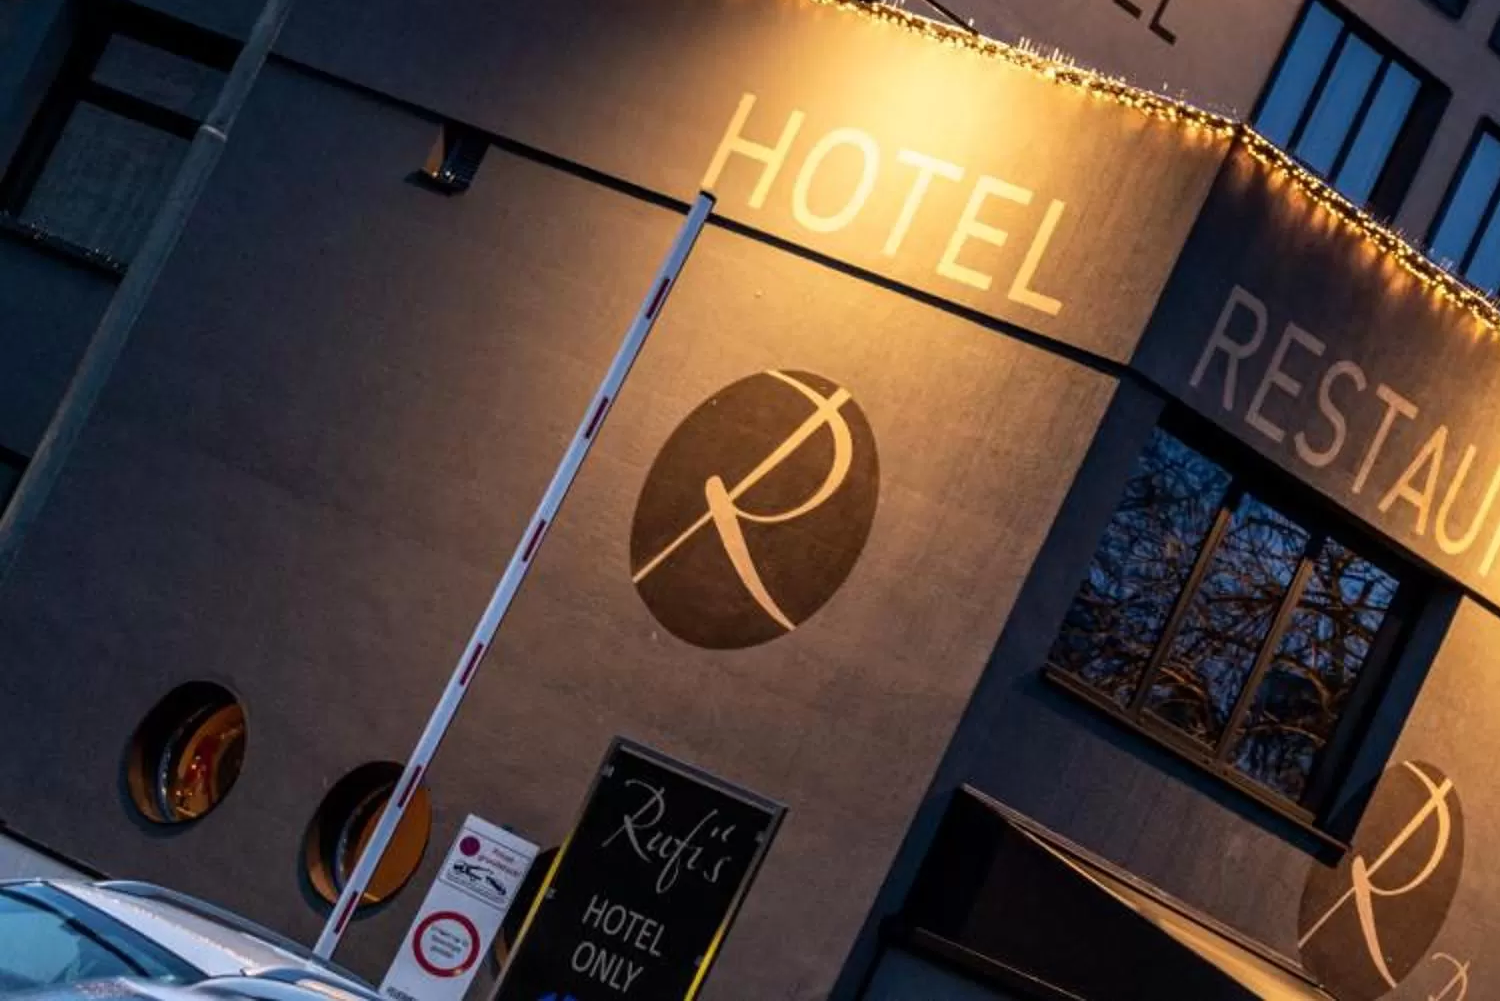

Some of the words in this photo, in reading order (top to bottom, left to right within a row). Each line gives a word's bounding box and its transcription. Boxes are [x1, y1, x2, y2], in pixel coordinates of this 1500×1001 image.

[699, 92, 1067, 316] HOTEL
[581, 893, 666, 957] HOTEL
[570, 940, 645, 994] ONLY
